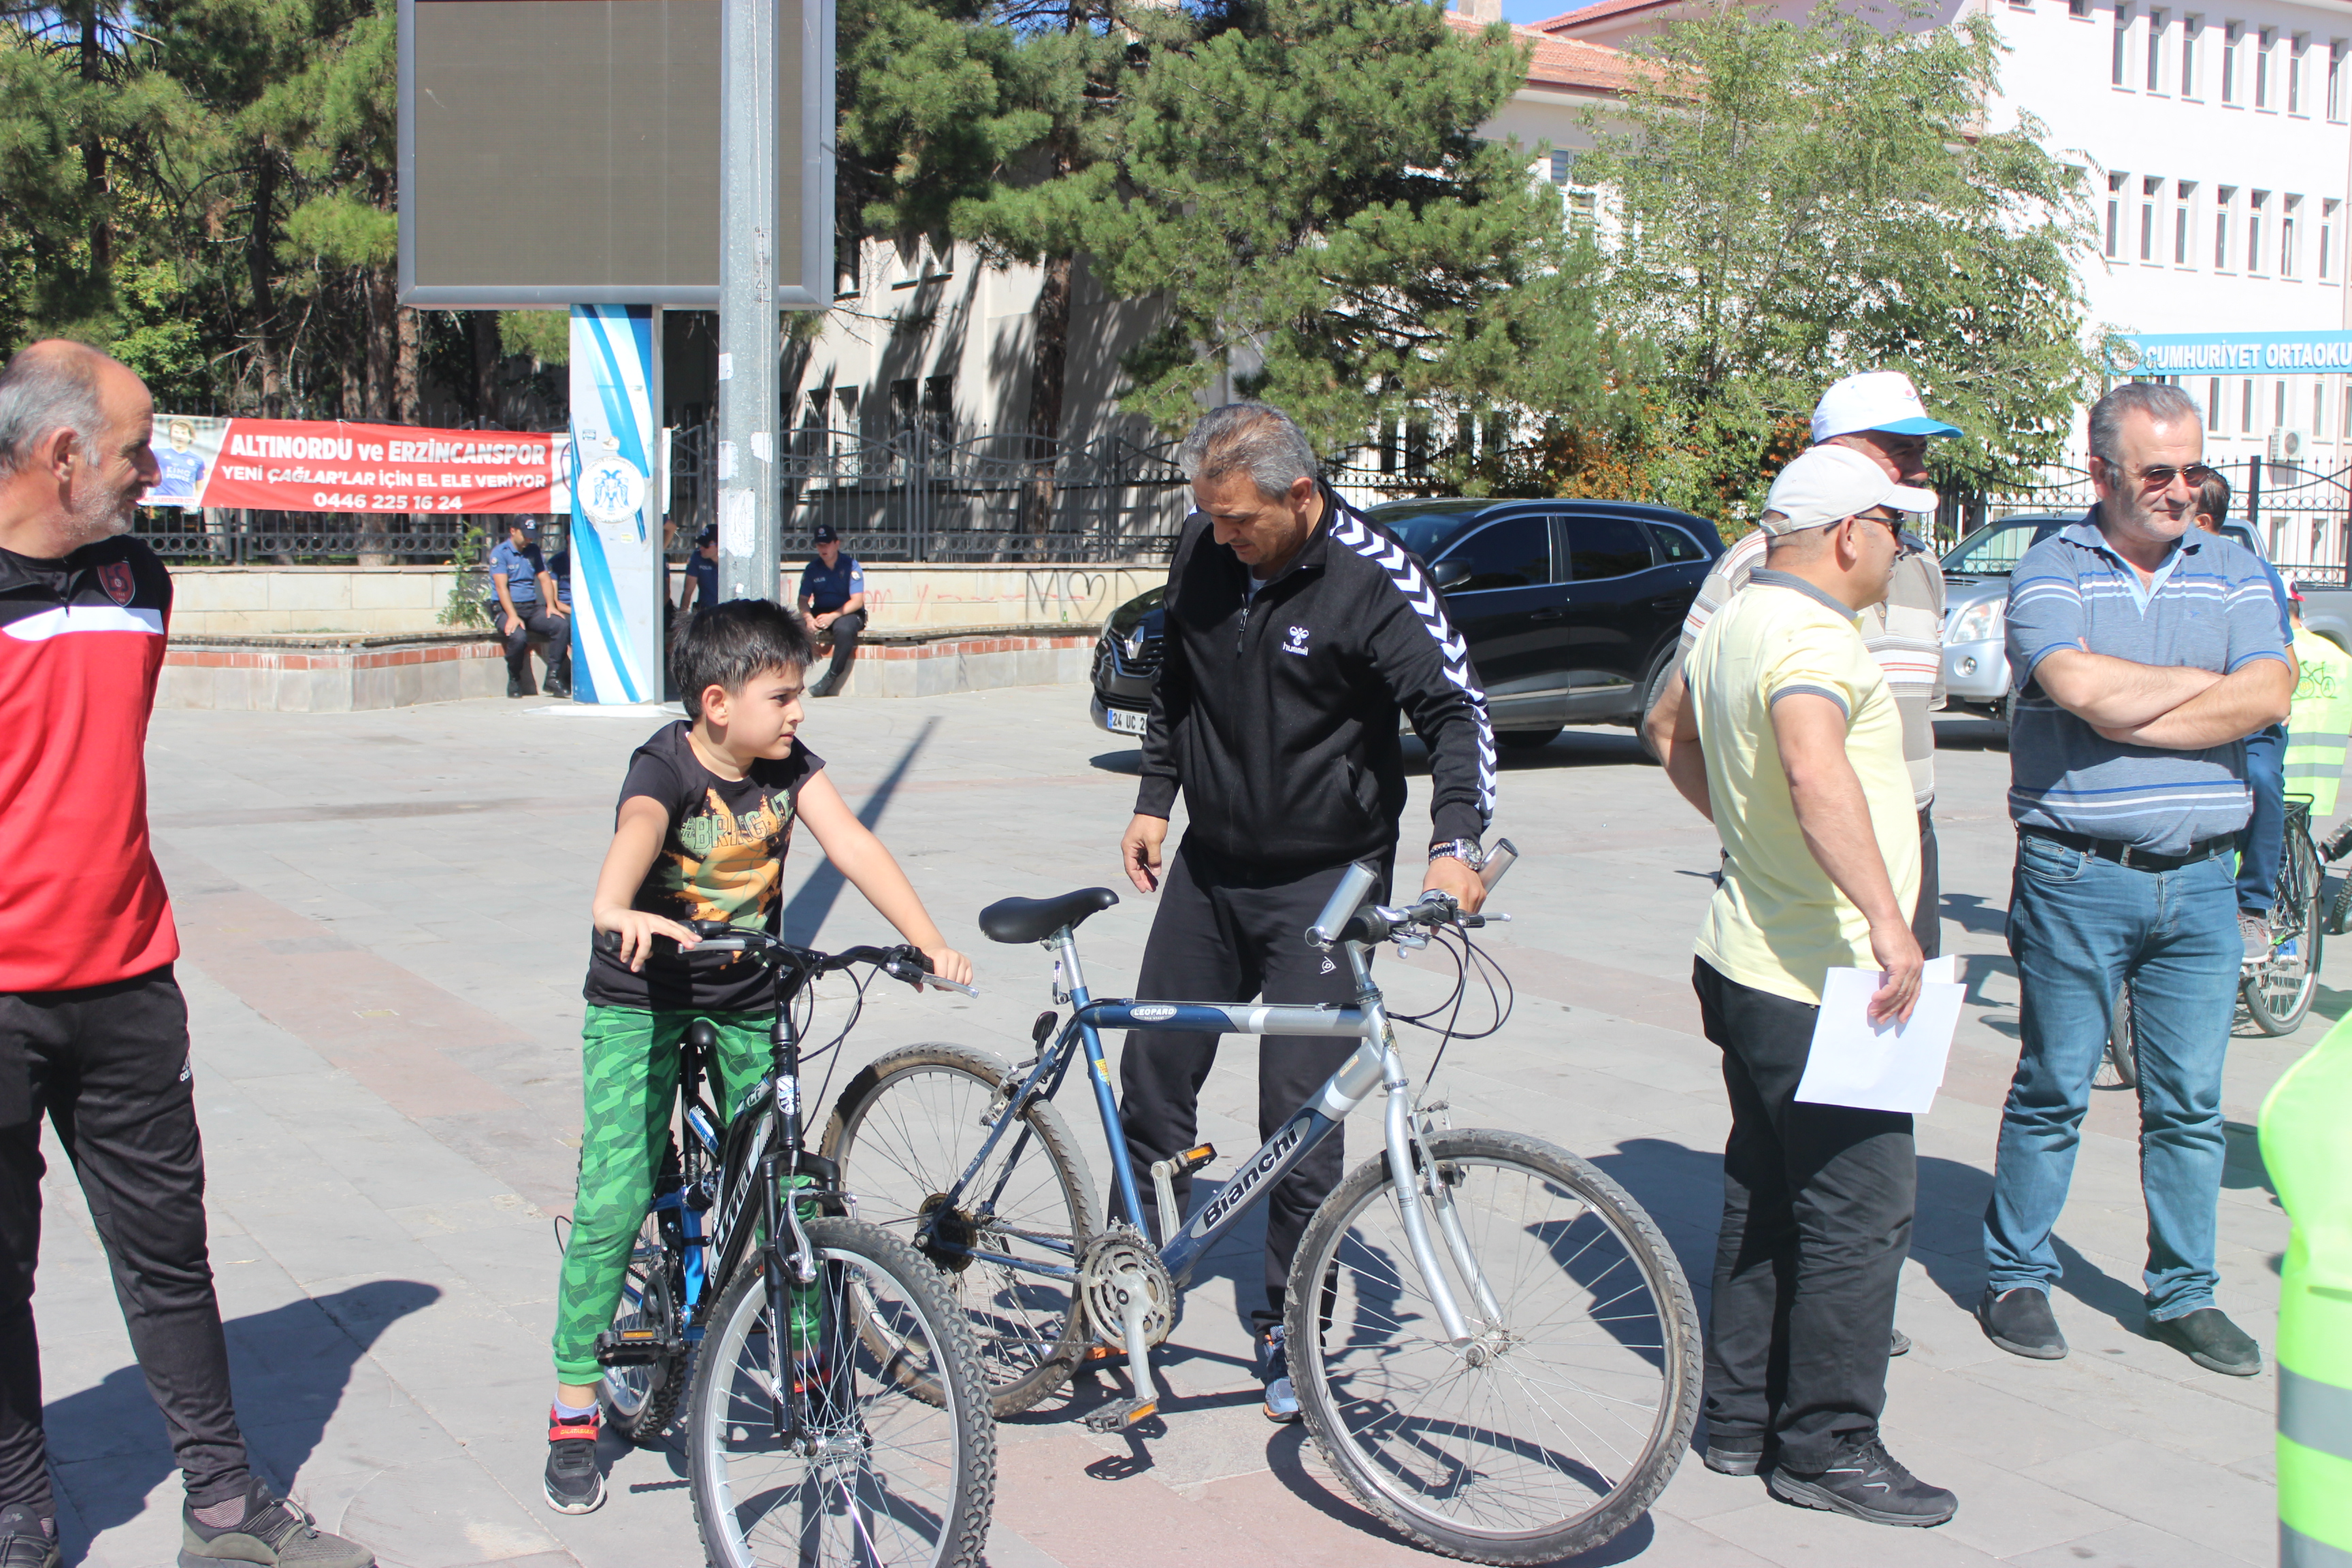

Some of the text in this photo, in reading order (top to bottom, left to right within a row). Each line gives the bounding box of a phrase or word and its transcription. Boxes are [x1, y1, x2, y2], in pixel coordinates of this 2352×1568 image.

[2144, 340, 2261, 370] CUMHURİYET
[230, 434, 546, 466] ALTINORDU ve ERZİNCANSPOR
[221, 465, 263, 480] YENİ
[379, 470, 412, 488] İÇİN
[417, 474, 438, 487] EL
[441, 474, 472, 488] ELE
[475, 472, 546, 488] VERİYOR
[313, 492, 463, 510] 0446 225 16 24
[1283, 641, 1309, 656] hummel
[1113, 713, 1122, 728] 24
[1126, 714, 1136, 730] UC
[1134, 1008, 1175, 1016] LEOPARD
[1203, 1124, 1302, 1232] Bianchi
